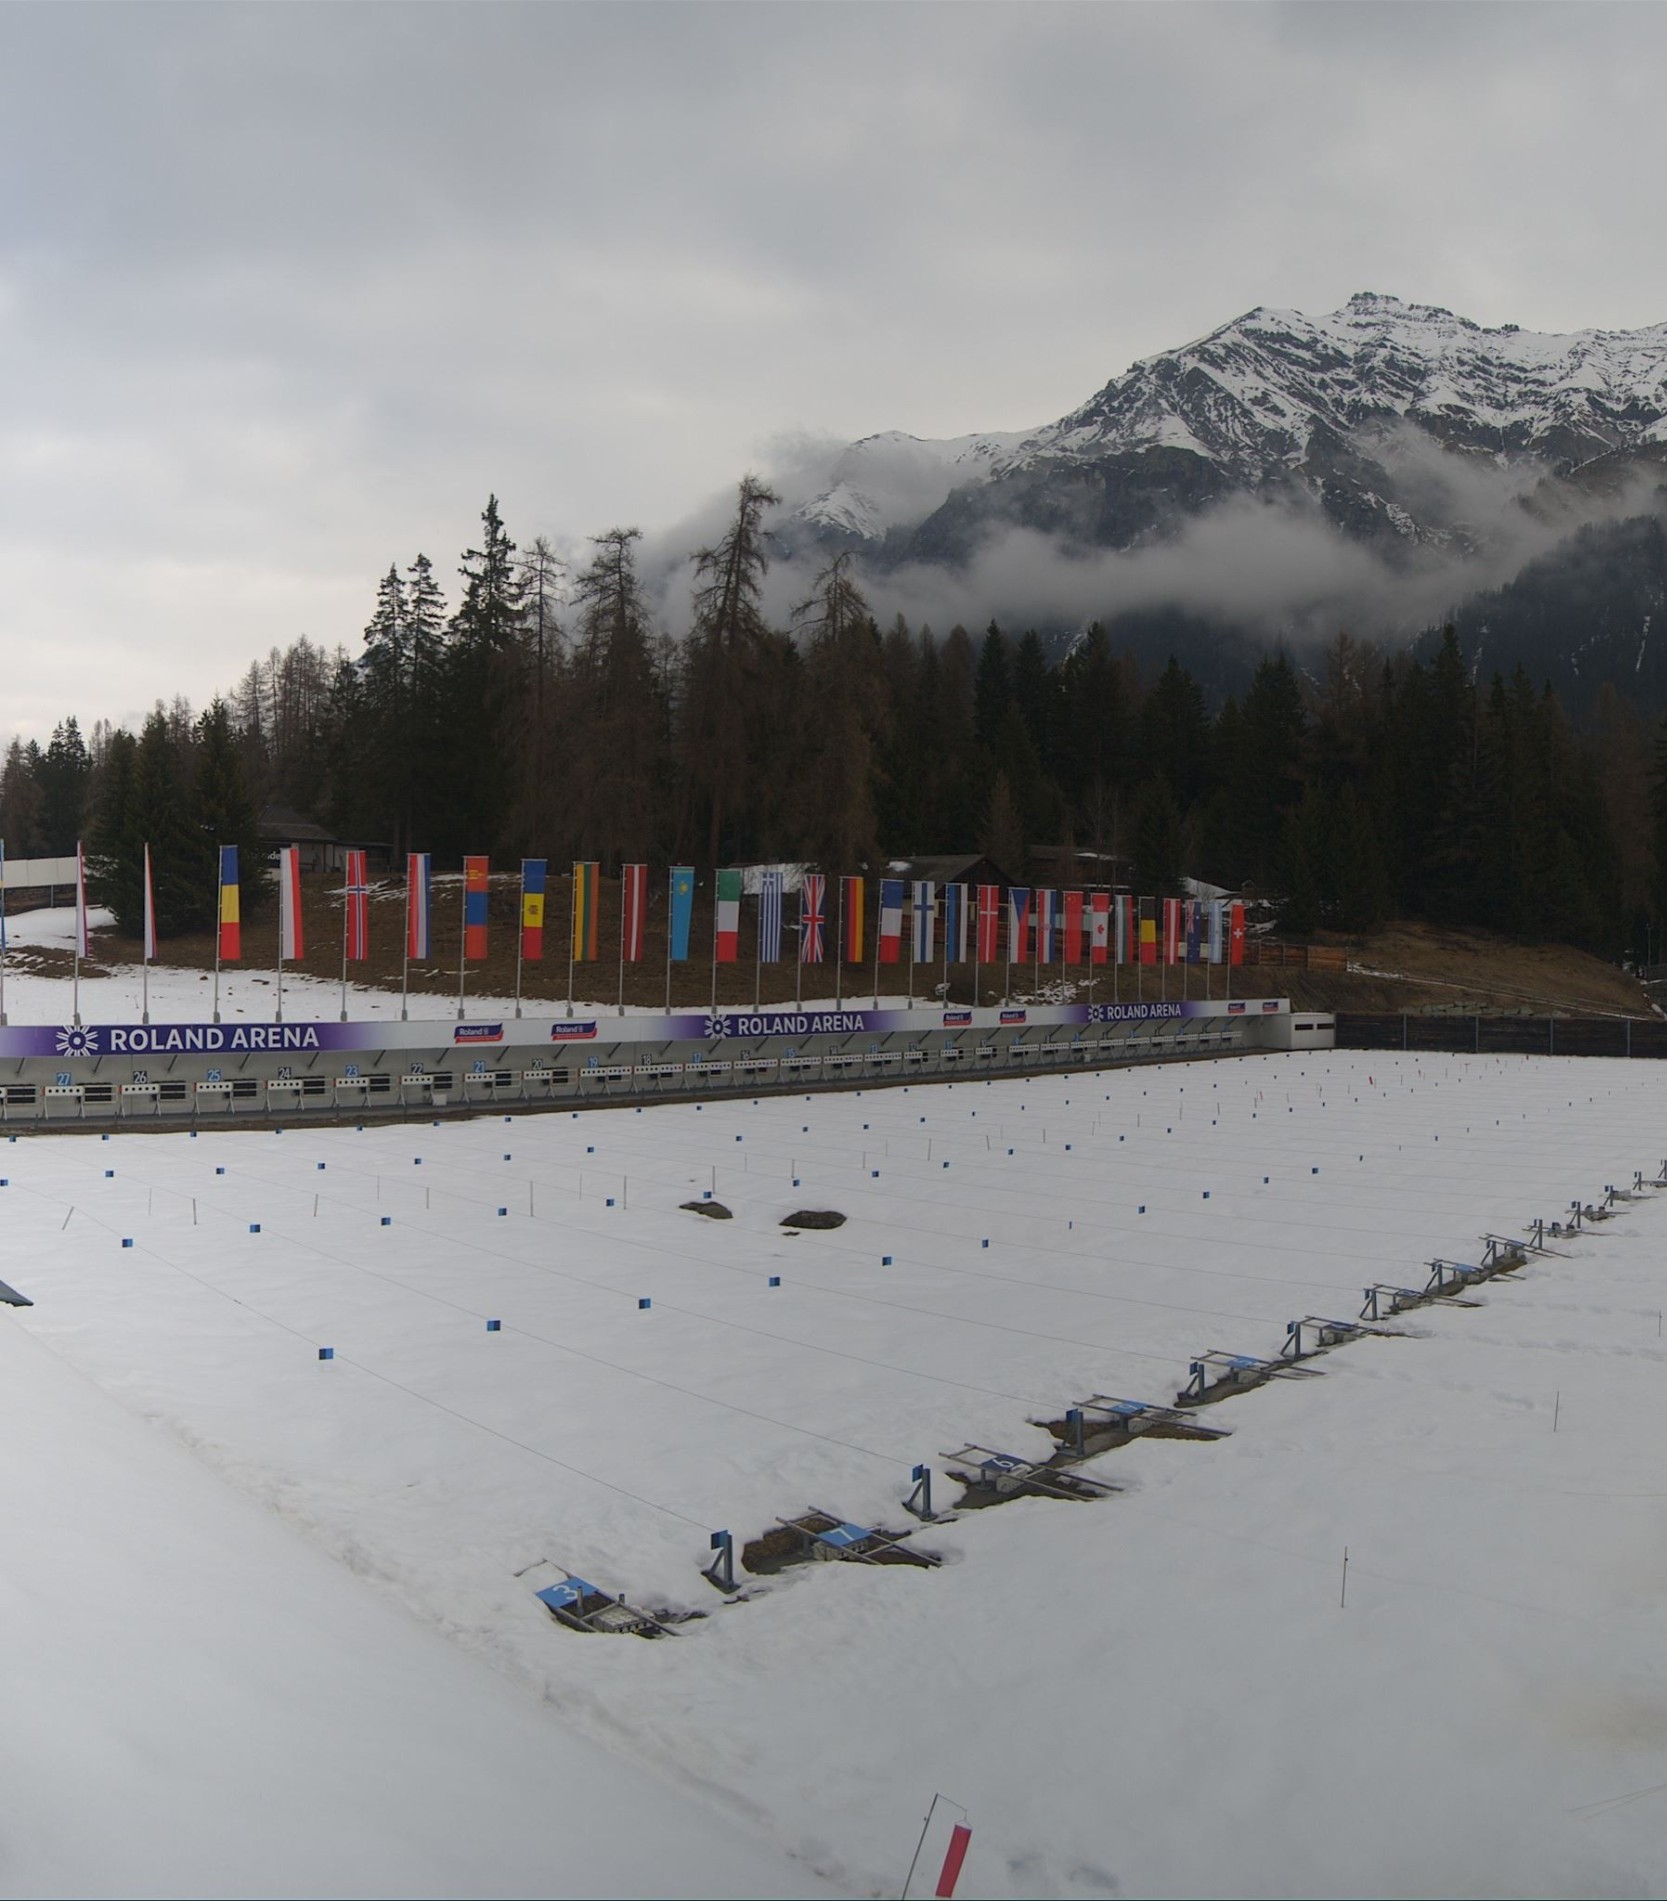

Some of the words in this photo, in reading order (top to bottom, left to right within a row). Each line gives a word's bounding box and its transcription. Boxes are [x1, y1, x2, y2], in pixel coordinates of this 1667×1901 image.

[1107, 1005, 1148, 1019] ROLAND
[1149, 1004, 1182, 1017] ARENA
[556, 1025, 579, 1034] Roland
[738, 1017, 808, 1035] ROLAND
[811, 1014, 864, 1033] ARENA
[459, 1027, 483, 1036] Roland
[110, 1028, 224, 1051] ROLAND
[230, 1026, 320, 1049] ARENA
[346, 1066, 358, 1077] 23
[411, 1064, 423, 1074] 22
[474, 1061, 485, 1072] 21
[133, 1071, 147, 1084] 26
[208, 1070, 220, 1081] 25
[279, 1067, 290, 1079] 24
[57, 1072, 71, 1086] 27
